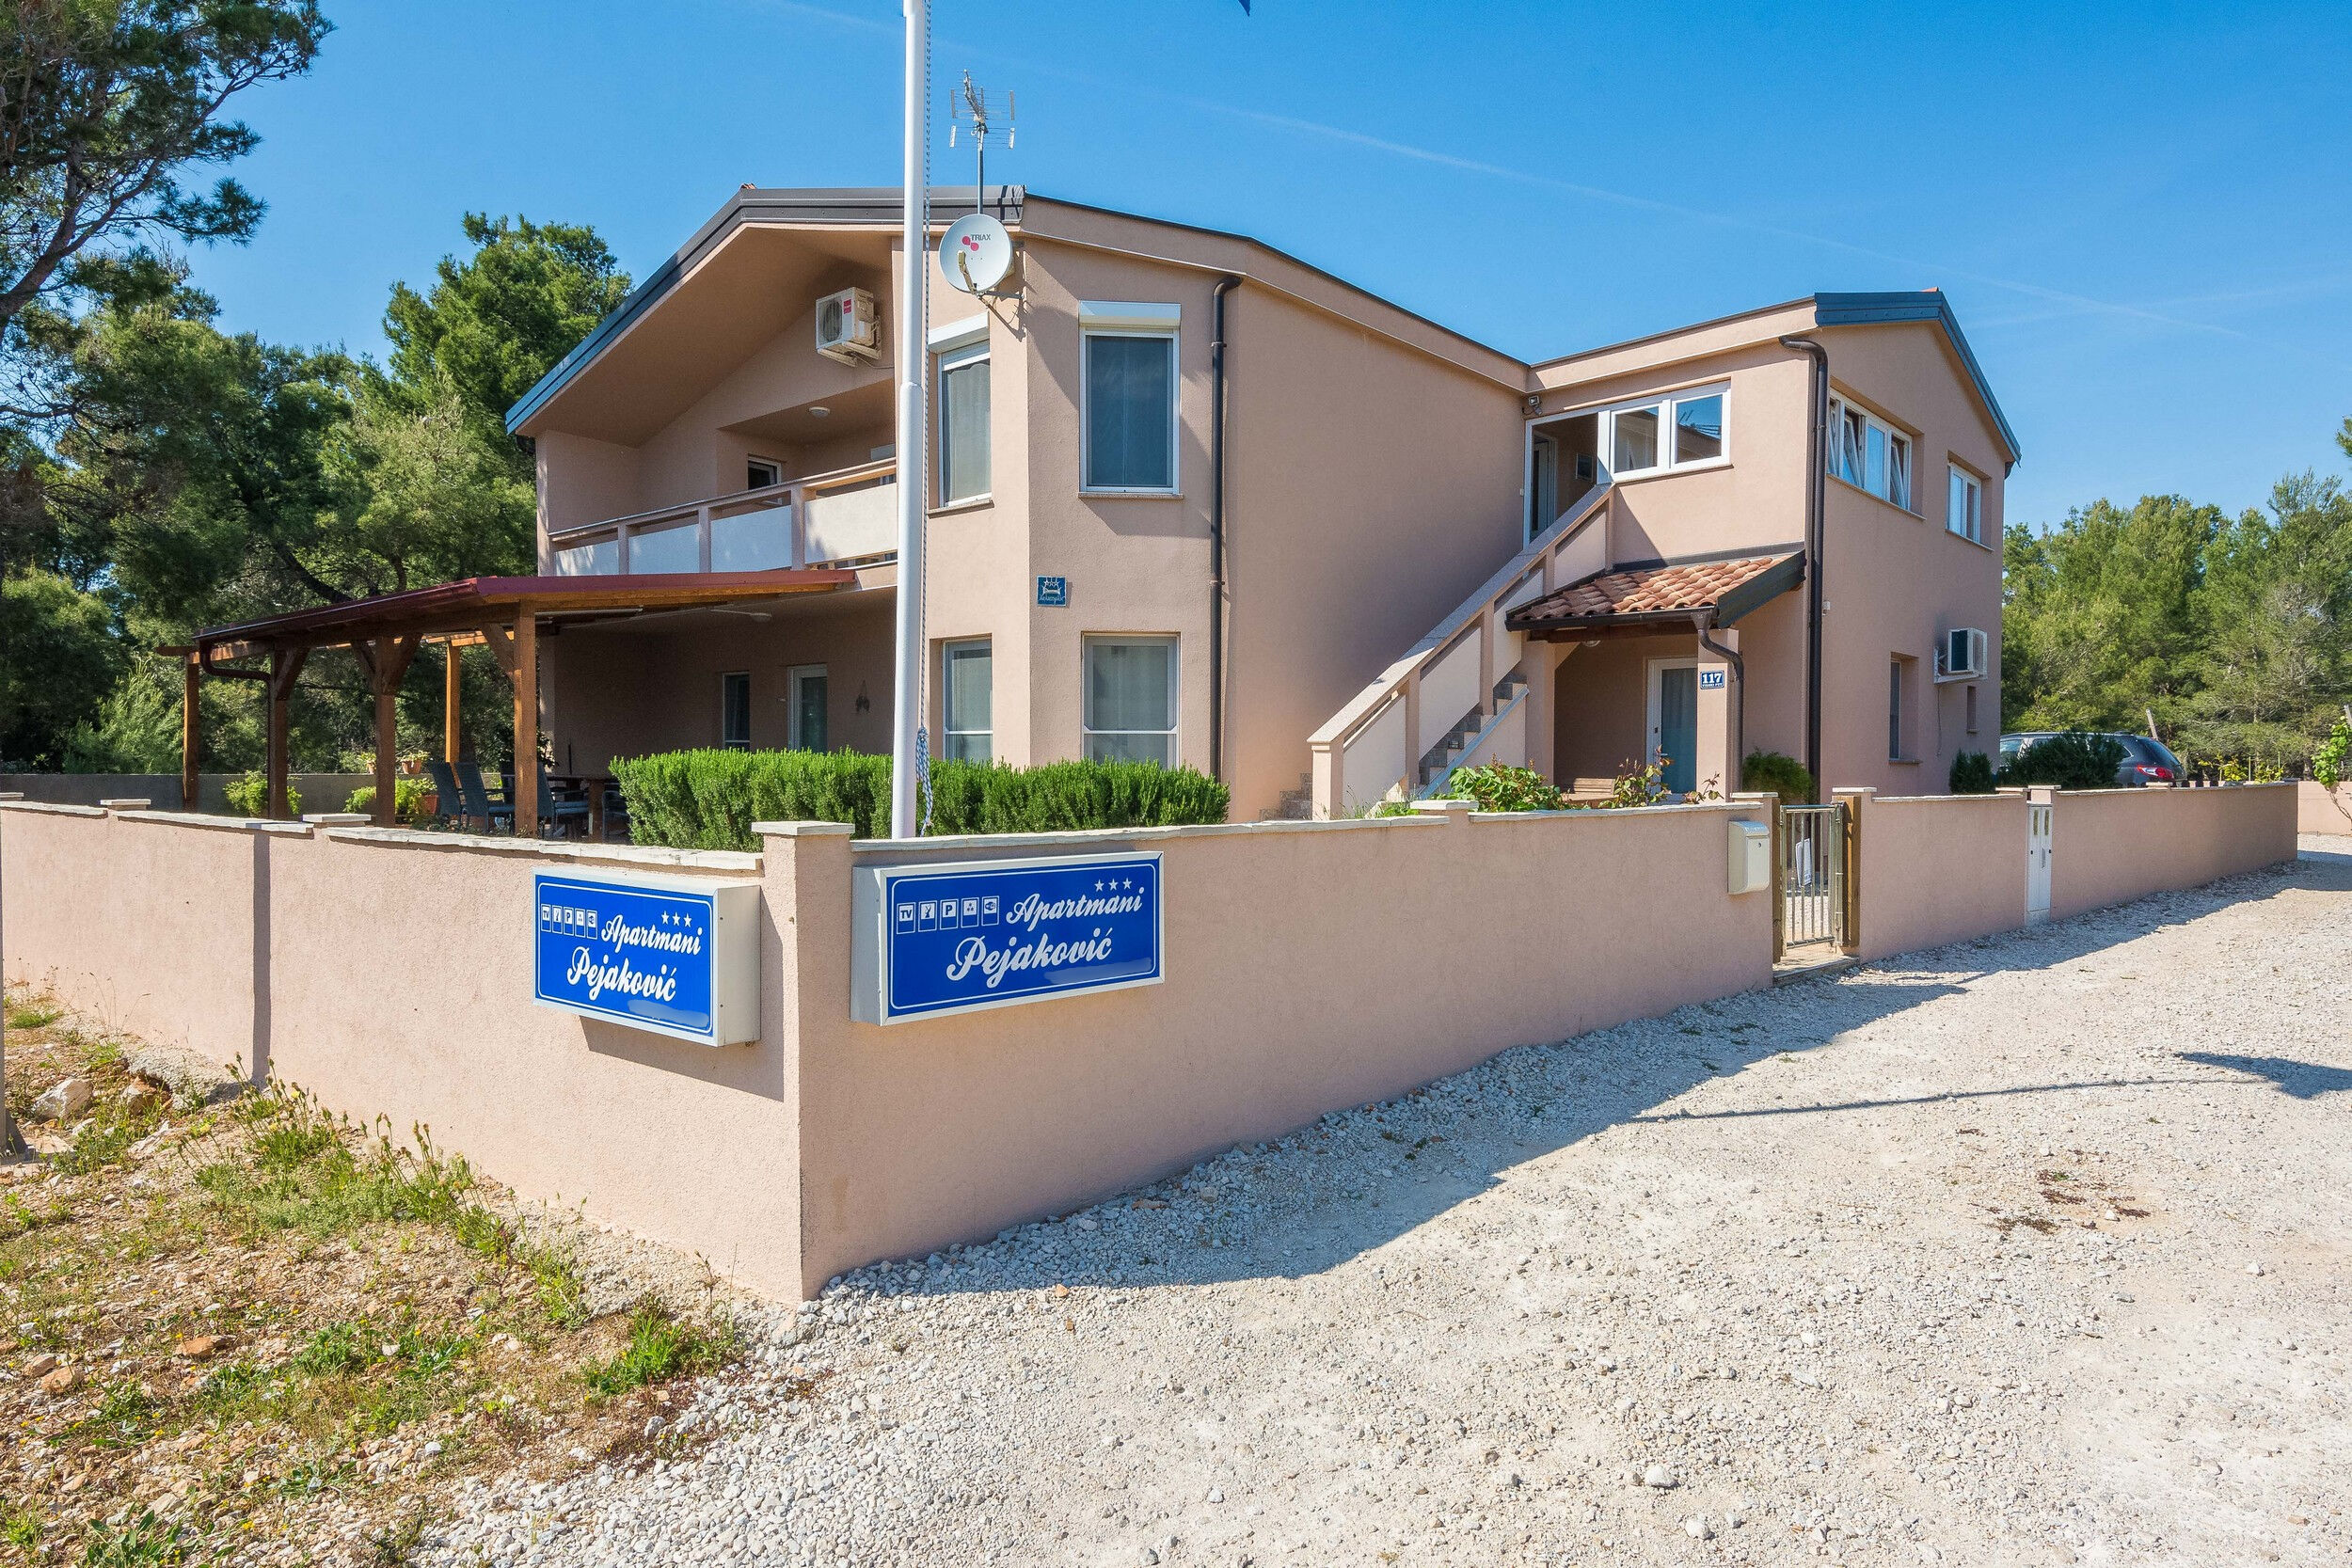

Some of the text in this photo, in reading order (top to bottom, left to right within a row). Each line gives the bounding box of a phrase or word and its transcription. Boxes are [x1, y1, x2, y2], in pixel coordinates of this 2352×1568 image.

[1702, 673, 1723, 684] 117
[566, 911, 571, 923] P
[900, 909, 913, 919] TV
[945, 904, 953, 916] P
[1006, 886, 1145, 932] Apartmani
[601, 914, 703, 956] Apartmani
[946, 927, 1113, 989] Pejaković
[566, 945, 676, 1002] Pejaković
